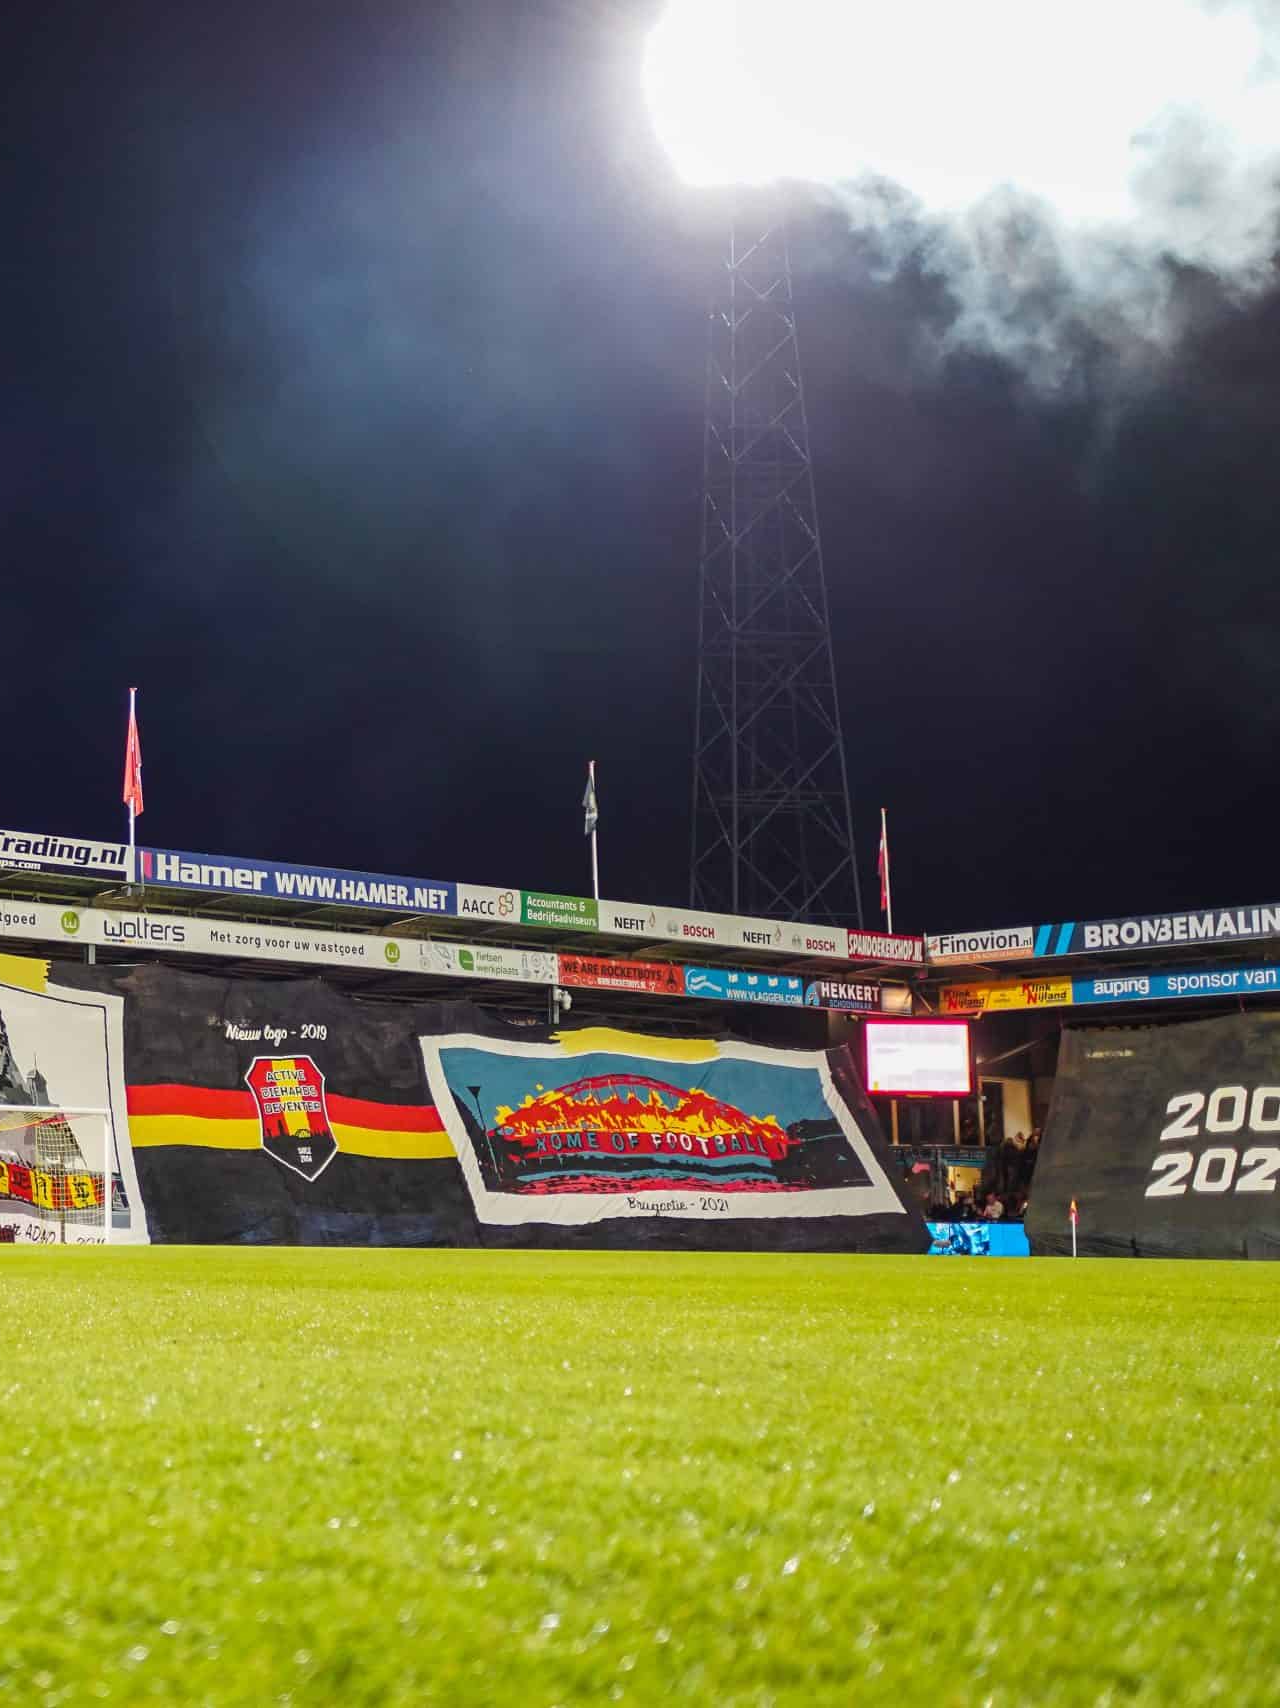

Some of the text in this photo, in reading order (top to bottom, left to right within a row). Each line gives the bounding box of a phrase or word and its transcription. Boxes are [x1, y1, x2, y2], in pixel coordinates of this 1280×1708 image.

[157, 854, 448, 910] Hamer WWW.HAMER.NET
[462, 899, 495, 915] AACC
[527, 896, 577, 911] Accountants
[104, 917, 185, 942] wolters
[614, 916, 645, 931] NEFIT
[683, 925, 715, 939] BOSCH
[210, 931, 364, 957] Met zorg voor uw vastgoed
[742, 931, 772, 945] NEFIT
[806, 938, 836, 951] BOSCH
[939, 932, 1032, 954] Finovion.nl
[1094, 968, 1277, 996] auping sponsor van
[821, 983, 880, 1001] HEKKERT
[225, 1024, 261, 1041] Nieuw
[264, 1024, 288, 1047] logo
[300, 1024, 328, 1041] 2019
[266, 1070, 306, 1082] ACTIVE
[612, 1132, 640, 1151] OF
[652, 1133, 768, 1155] FOOTBALL
[700, 1198, 729, 1213] 2021
